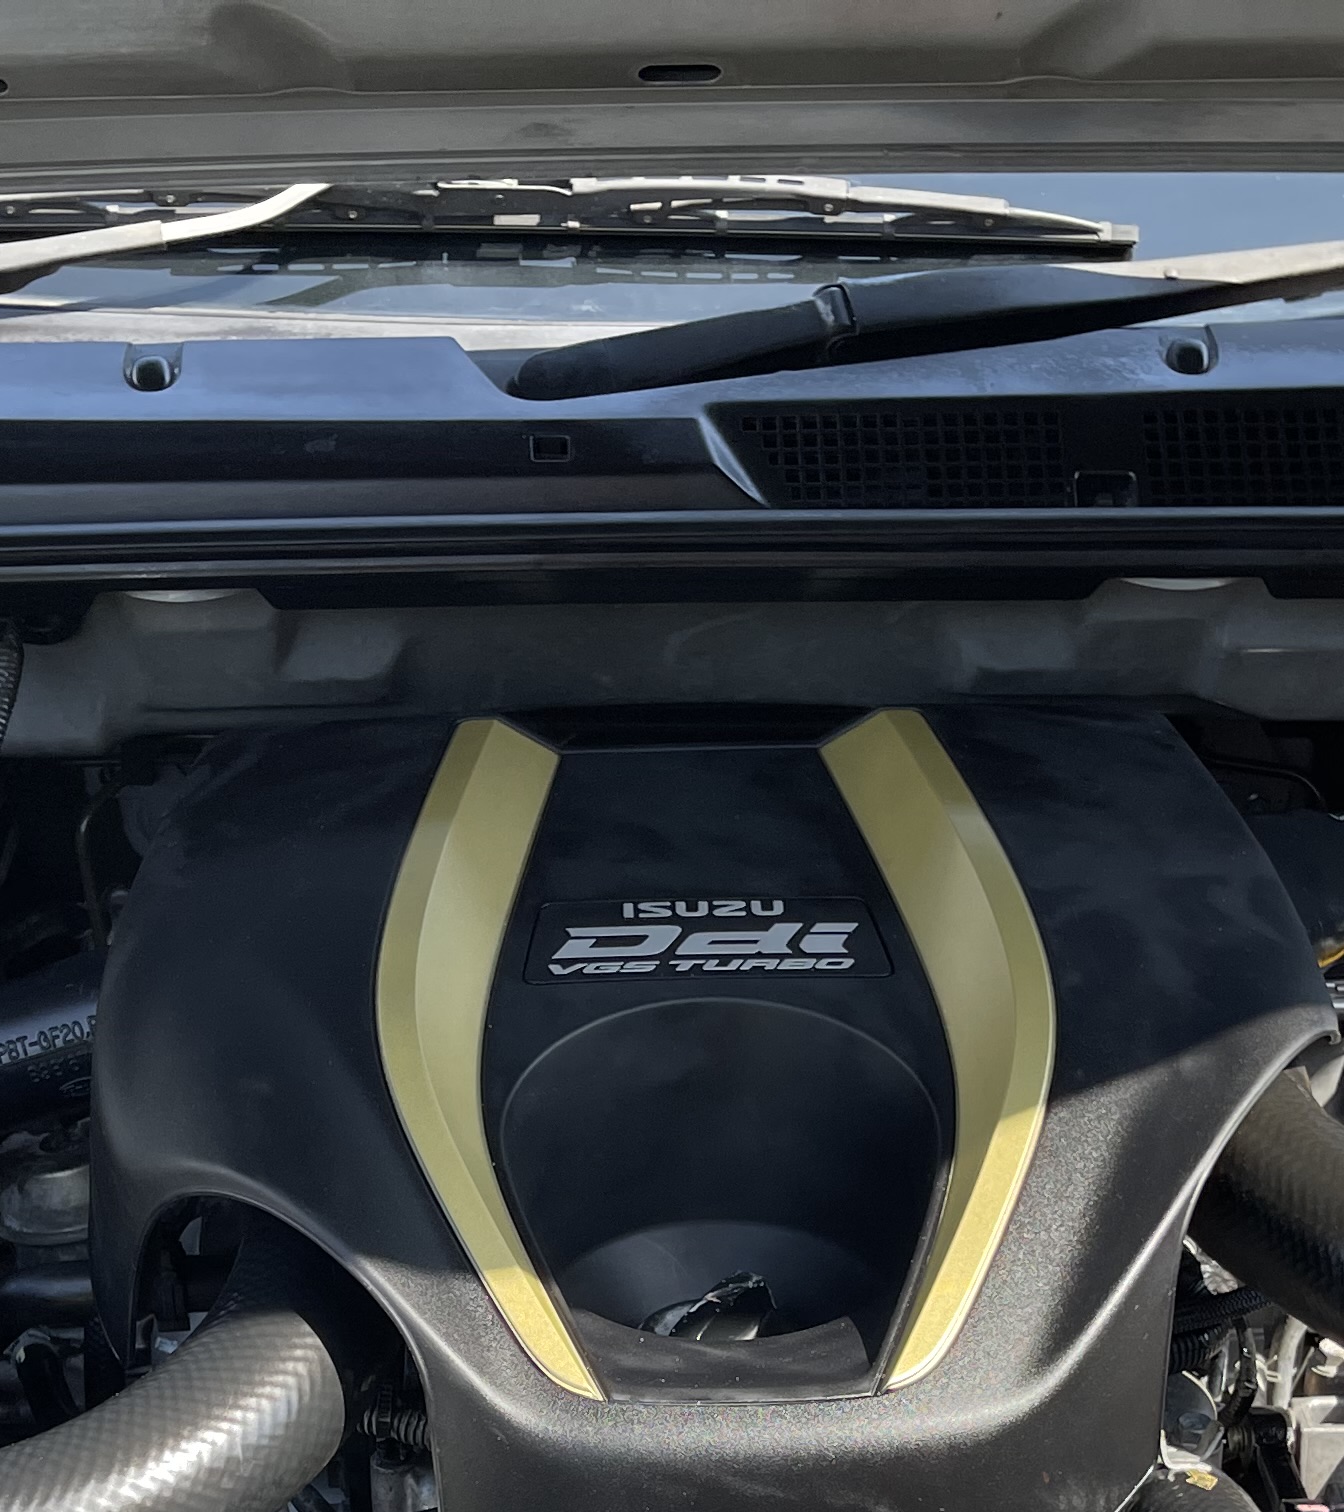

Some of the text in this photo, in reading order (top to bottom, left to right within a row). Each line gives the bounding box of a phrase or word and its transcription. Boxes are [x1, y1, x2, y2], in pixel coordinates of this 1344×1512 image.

[622, 900, 784, 919] ISUZU
[548, 957, 855, 975] VGS TURBO
